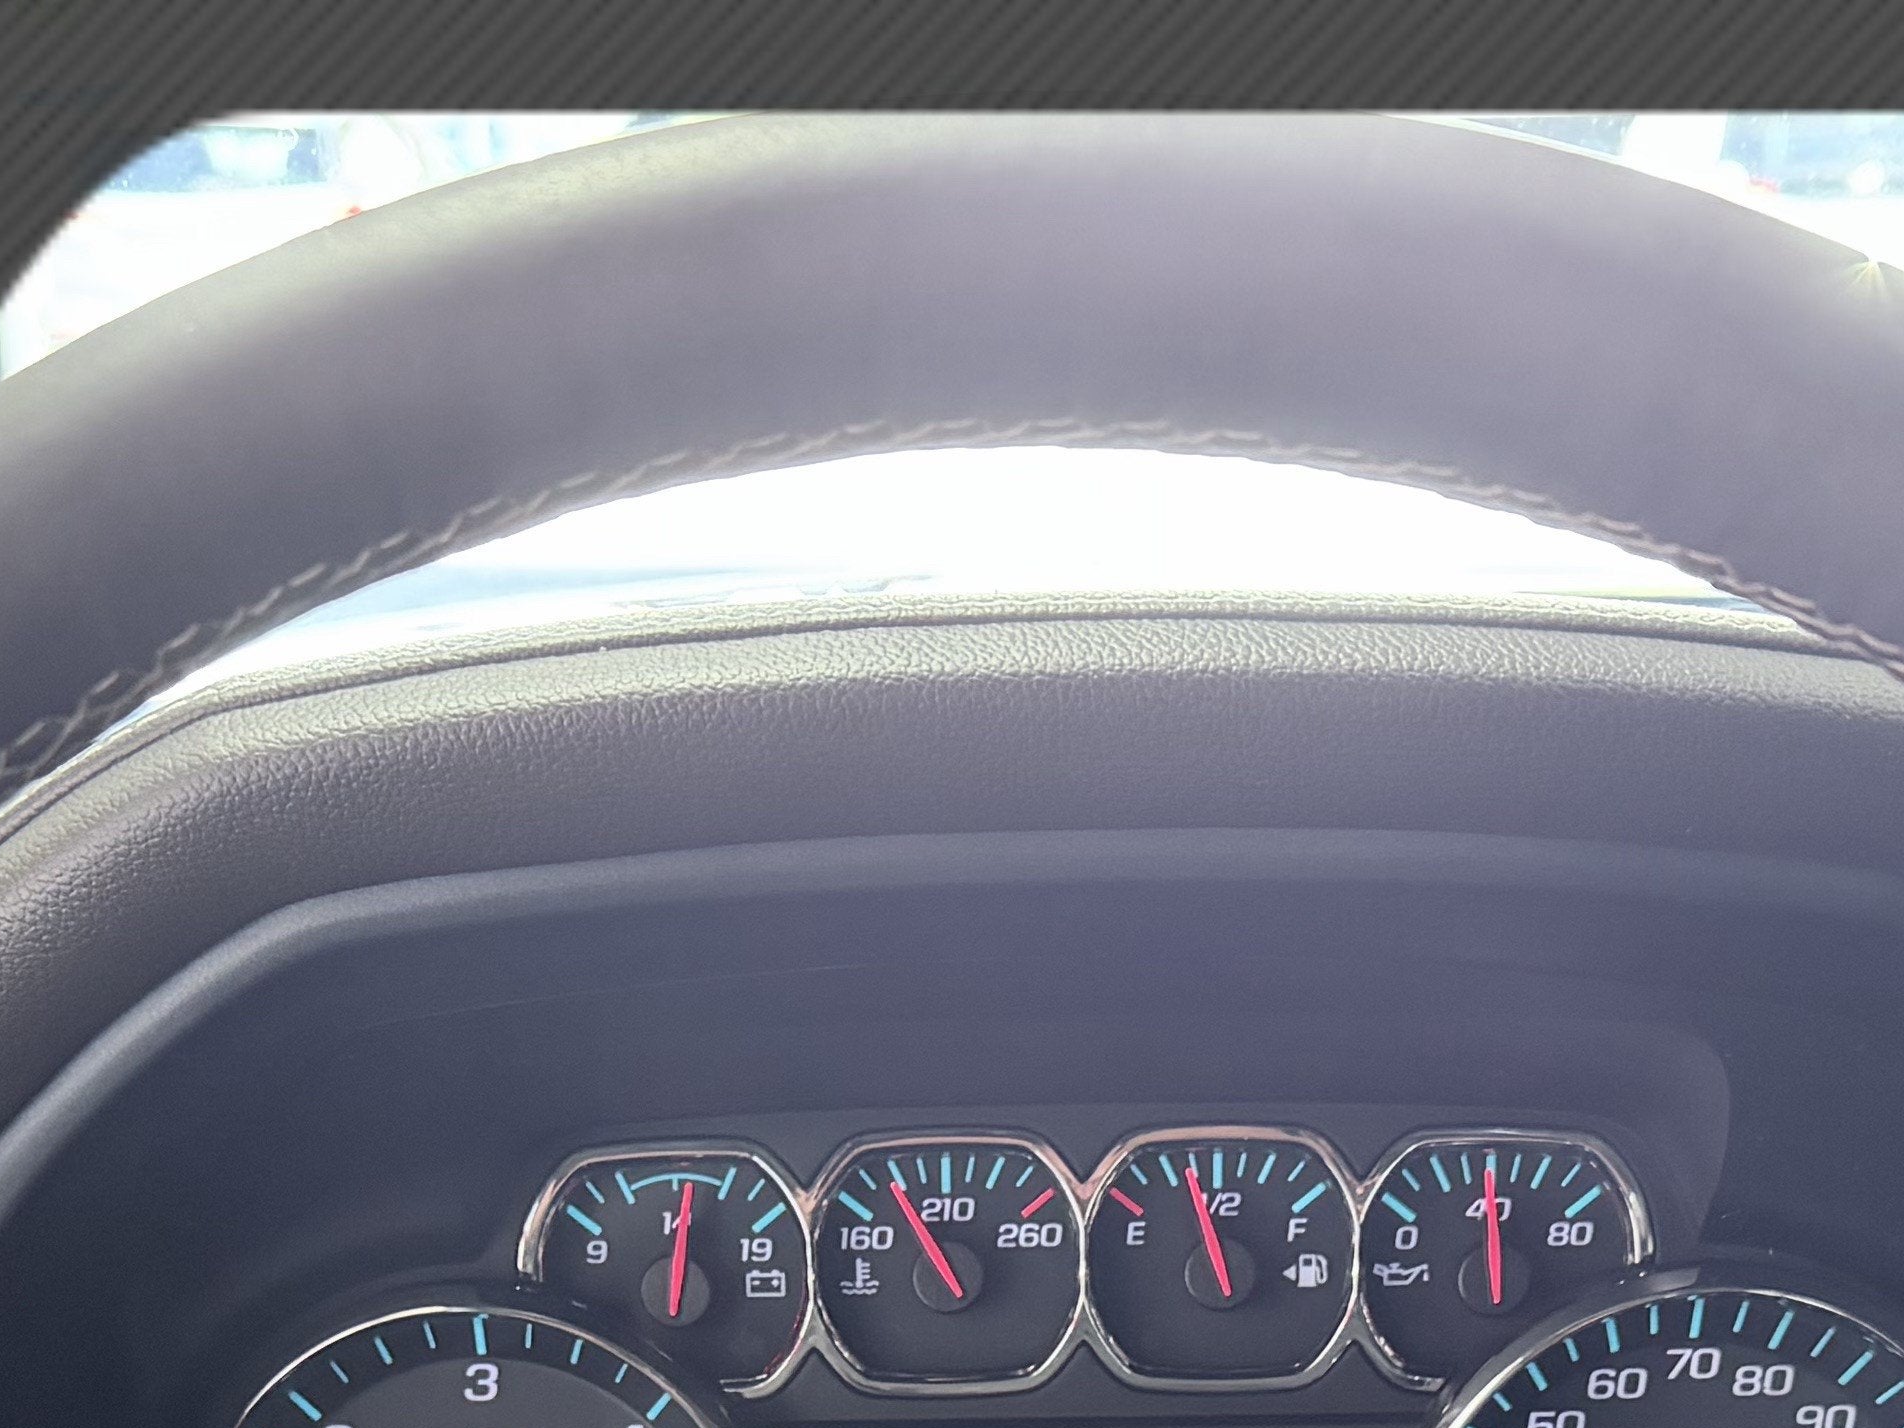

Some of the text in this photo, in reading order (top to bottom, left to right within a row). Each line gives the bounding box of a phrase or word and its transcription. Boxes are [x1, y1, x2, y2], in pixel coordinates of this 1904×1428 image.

[919, 1196, 976, 1223] 210
[840, 1224, 894, 1251] 160
[997, 1221, 1064, 1249] 260
[1126, 1220, 1146, 1247] E
[1286, 1217, 1309, 1243] F
[1394, 1224, 1419, 1251] 0
[1546, 1221, 1595, 1247] 80
[586, 1241, 608, 1265] 9
[739, 1236, 774, 1263] 19
[1666, 1347, 1722, 1380] 70
[464, 1363, 499, 1402] 3
[1587, 1367, 1648, 1400] 60
[1732, 1364, 1795, 1397] 80
